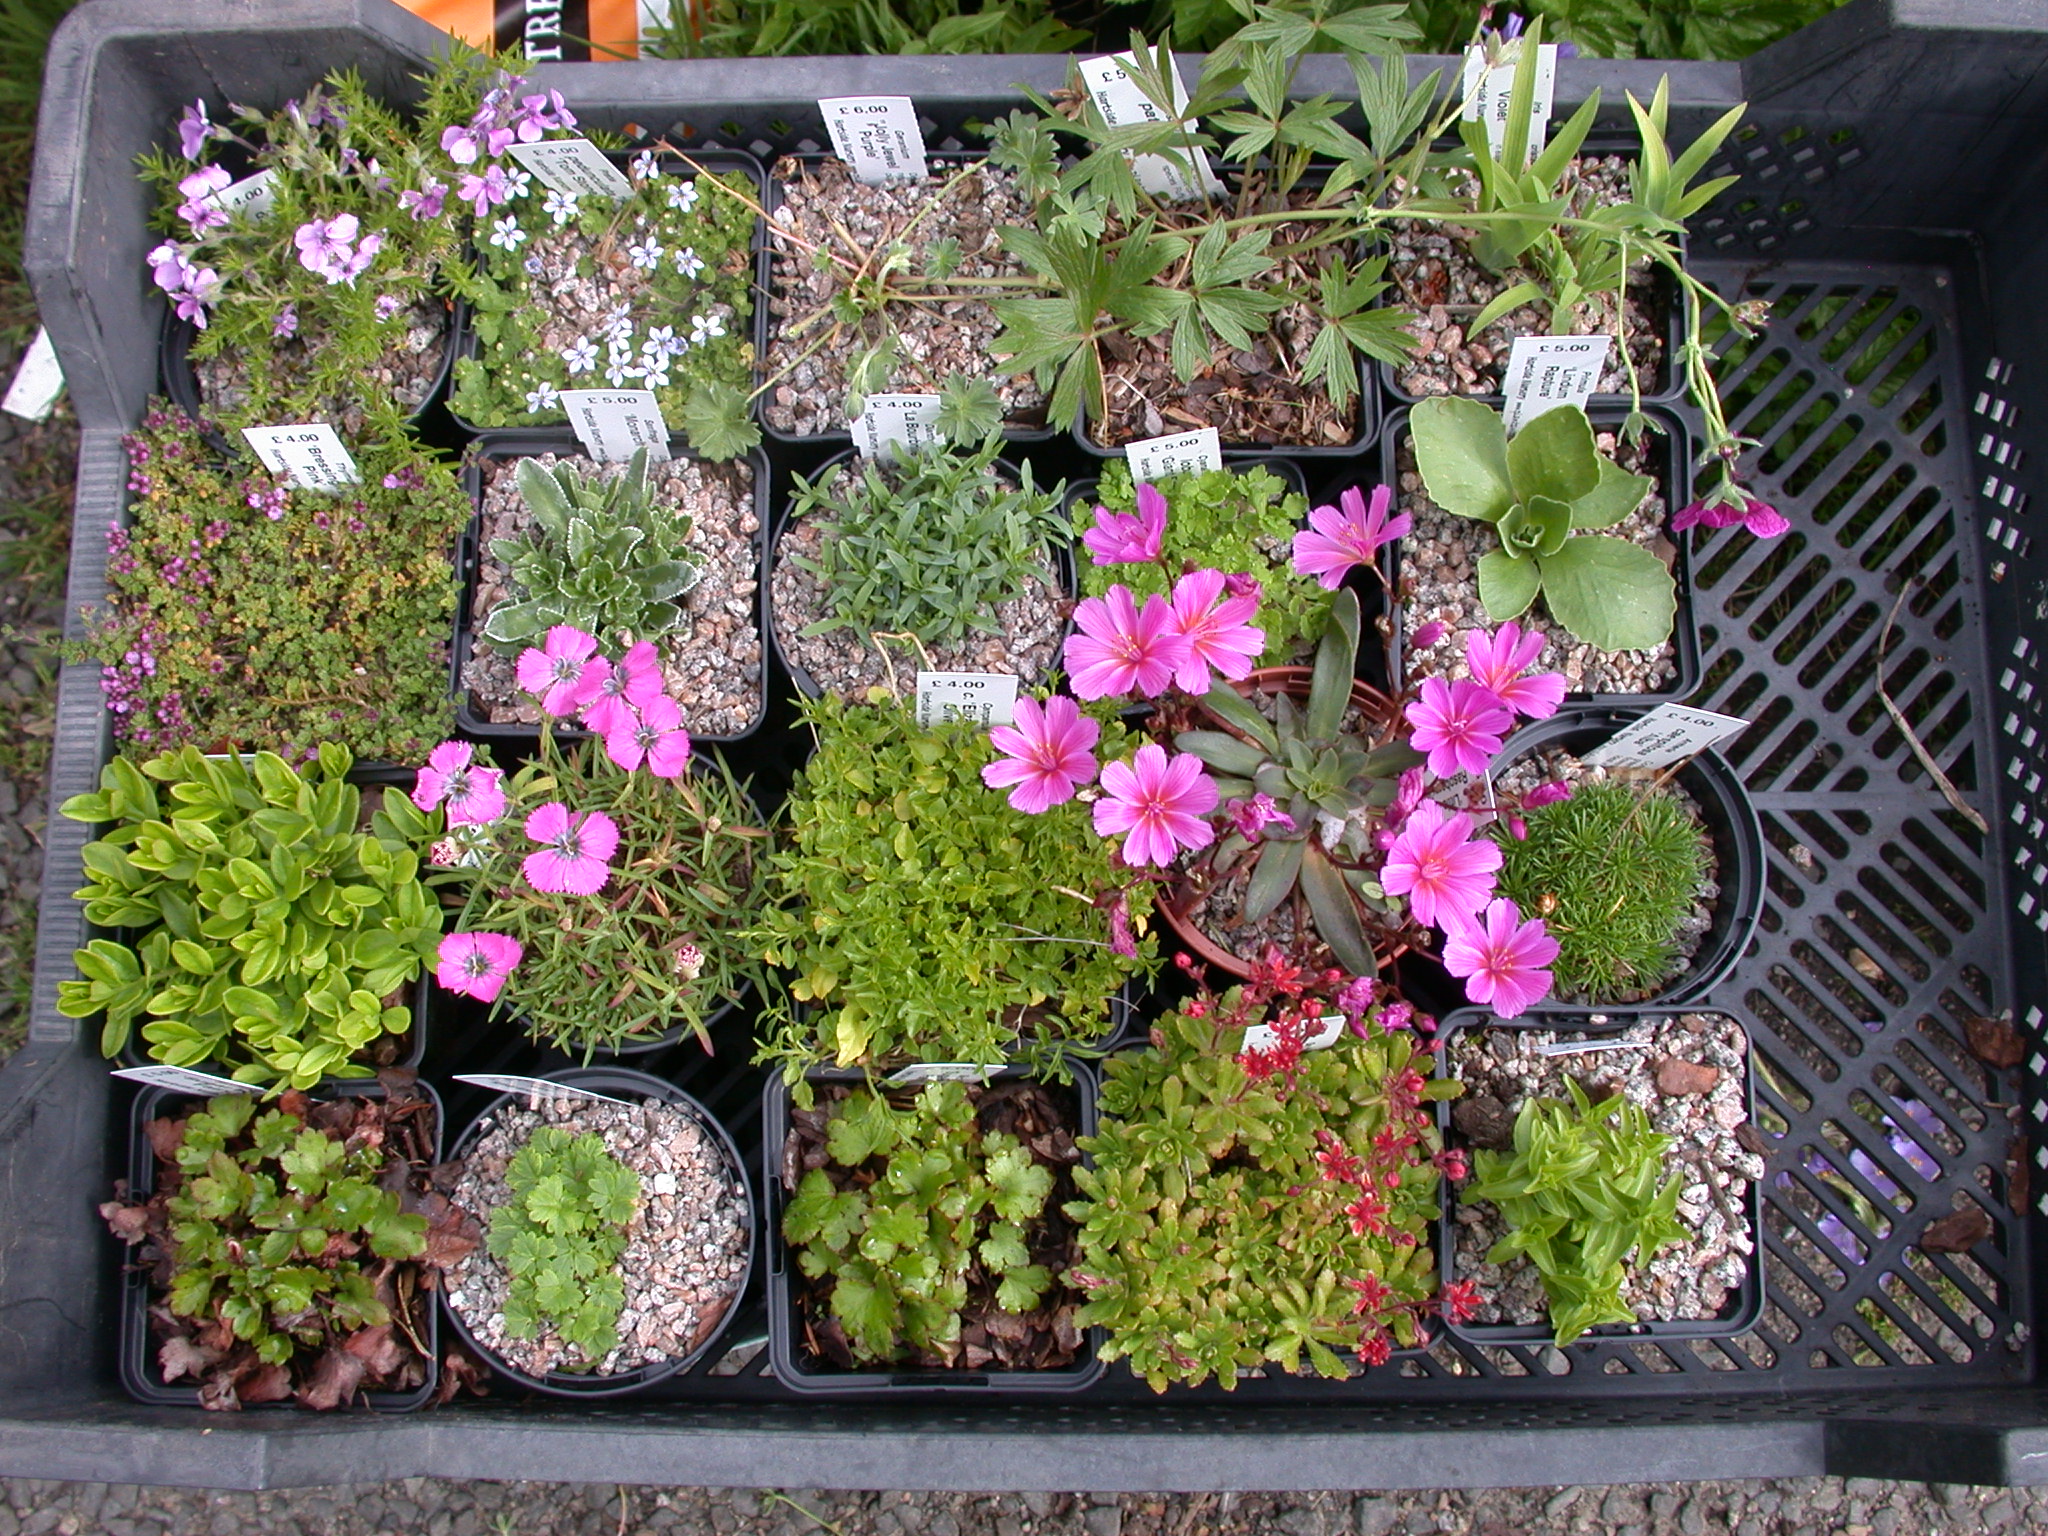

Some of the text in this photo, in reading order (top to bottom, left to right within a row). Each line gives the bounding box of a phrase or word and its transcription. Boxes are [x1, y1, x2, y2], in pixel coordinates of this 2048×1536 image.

[854, 105, 888, 113] 6.00
[1095, 90, 1117, 125] Hartside
[1137, 102, 1159, 121] pat
[1555, 344, 1590, 352] 5.00
[271, 434, 318, 444] £ 4.00
[1165, 439, 1198, 450] 5.00
[306, 444, 342, 485] 'Bressing
[1679, 716, 1714, 727] 4.00
